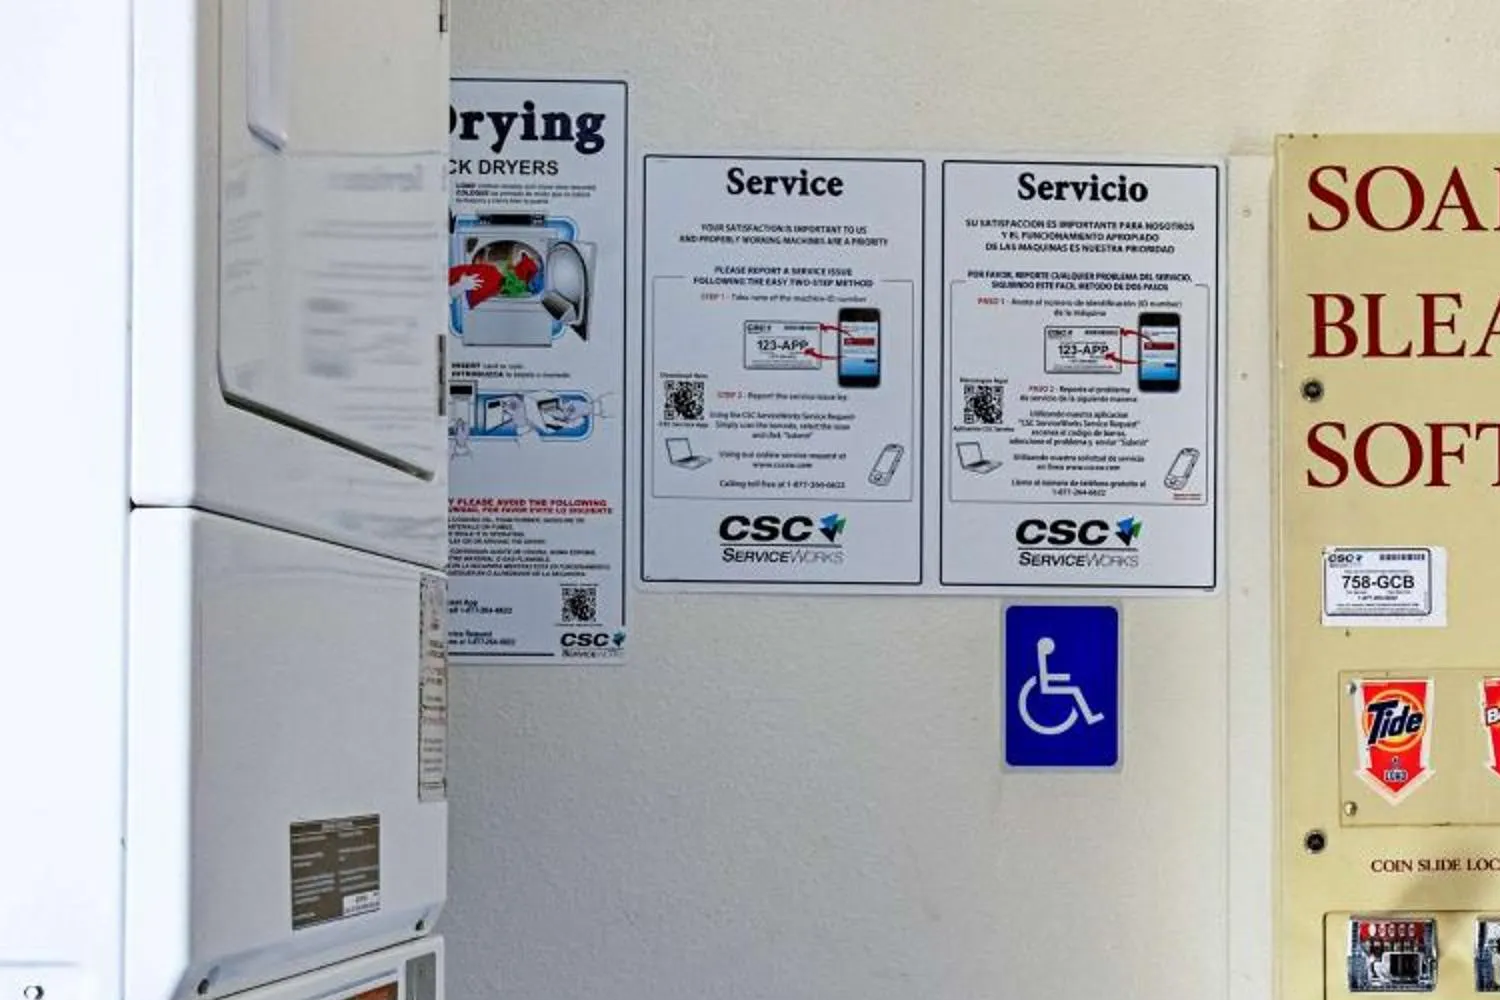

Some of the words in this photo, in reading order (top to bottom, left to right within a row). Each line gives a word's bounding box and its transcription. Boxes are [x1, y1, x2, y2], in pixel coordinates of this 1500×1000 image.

[450, 100, 606, 155] rying
[727, 167, 843, 196] Service
[1018, 172, 1148, 203] Servicio
[719, 515, 813, 541] CSC
[1016, 520, 1109, 546] CSC
[1019, 552, 1139, 567] SERVICEWORKS
[1342, 575, 1414, 589] 758-GCB
[561, 633, 609, 647] CSC
[1368, 700, 1423, 745] Tide
[1371, 857, 1412, 873] COIN
[1418, 857, 1464, 873] SLIDE
